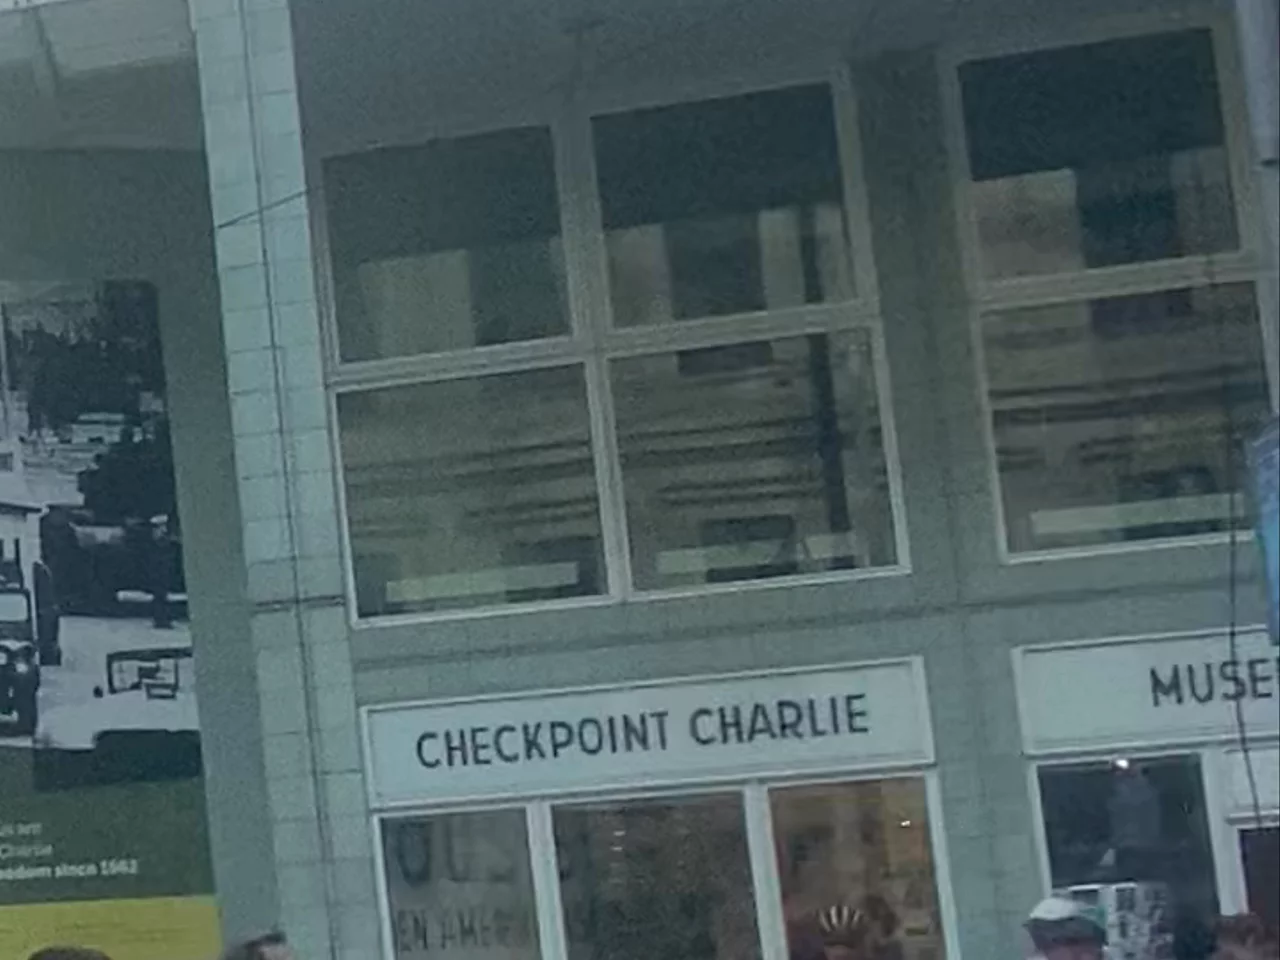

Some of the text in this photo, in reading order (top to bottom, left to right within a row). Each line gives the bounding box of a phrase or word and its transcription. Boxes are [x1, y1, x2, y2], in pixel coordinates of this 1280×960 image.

[1149, 657, 1280, 707] MUSE
[415, 692, 871, 770] CHECKPOINT CHARLIE
[54, 862, 97, 878] since
